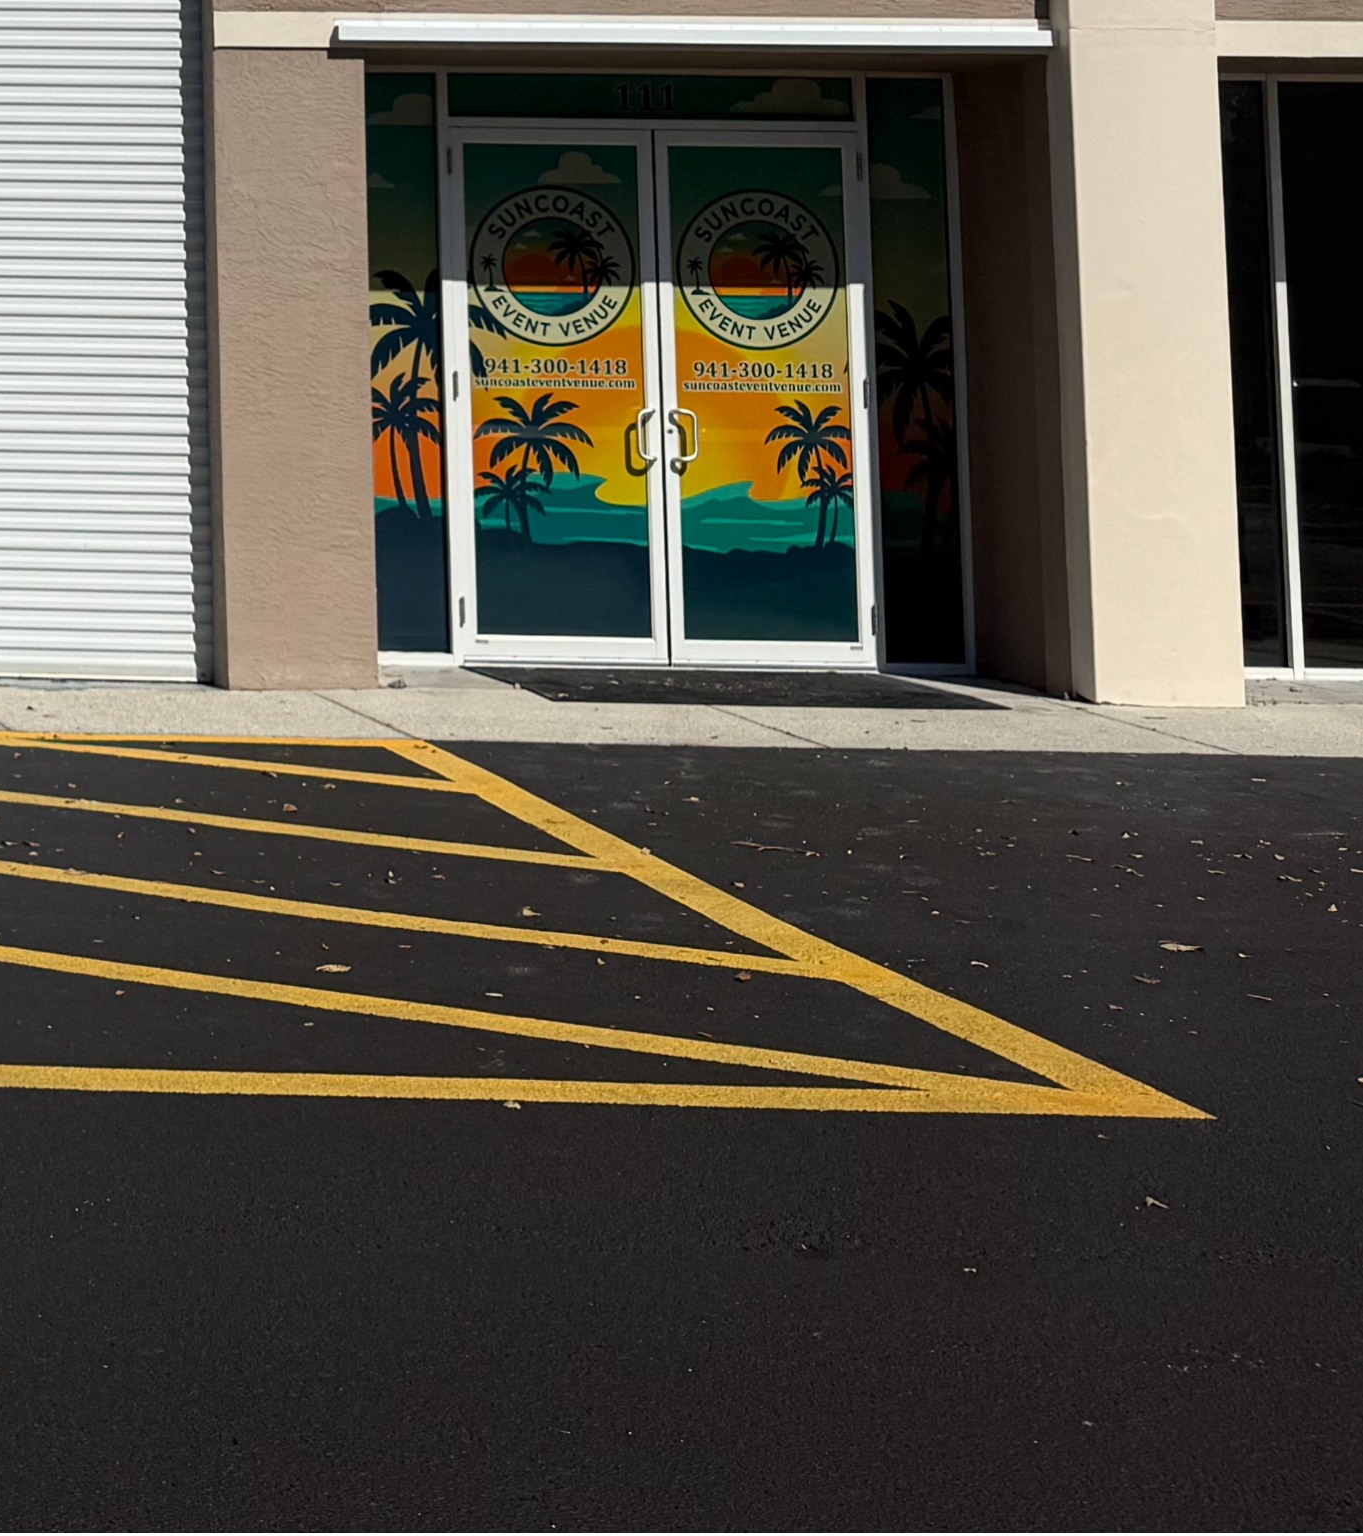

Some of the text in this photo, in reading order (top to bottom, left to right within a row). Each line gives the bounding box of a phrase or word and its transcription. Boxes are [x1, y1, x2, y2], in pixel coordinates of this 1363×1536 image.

[614, 82, 676, 112] 111
[488, 195, 616, 239] SUNCOAST
[694, 198, 820, 243] SUNCOAST
[491, 295, 618, 337] EVENT VENUE
[698, 298, 823, 341] EVENT VENUE
[485, 358, 627, 375] 941-300-1418
[694, 362, 833, 379] 941-300-1418
[474, 378, 636, 389] suncoasteventvenue.com
[683, 381, 842, 393] suncoasteventvenue.com
